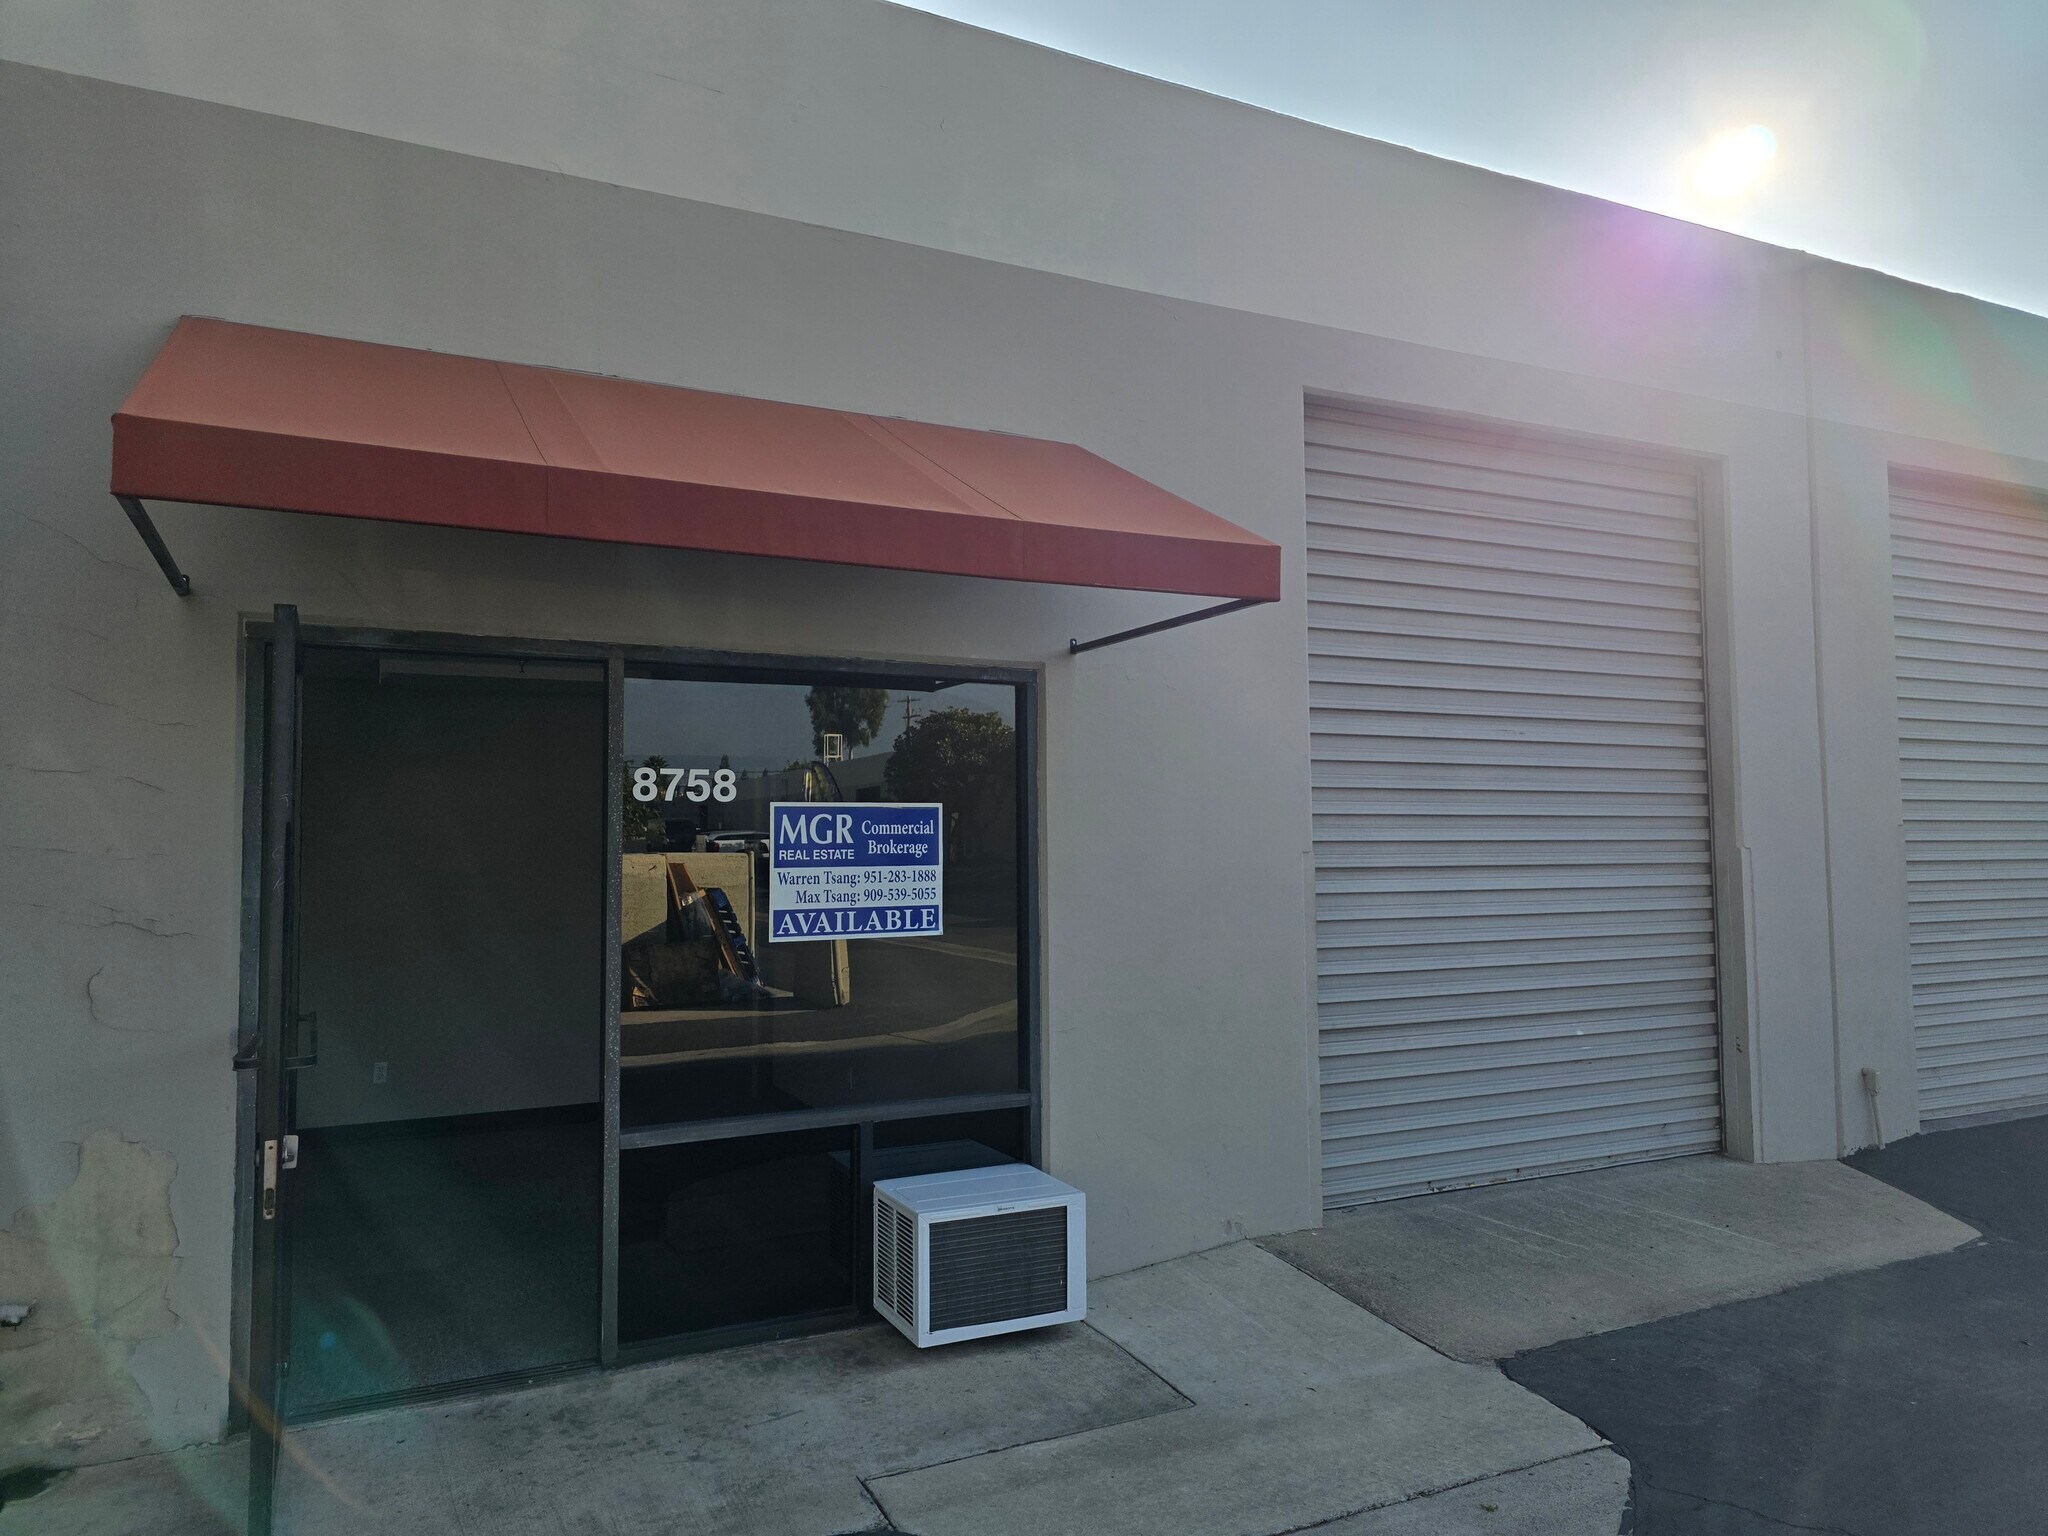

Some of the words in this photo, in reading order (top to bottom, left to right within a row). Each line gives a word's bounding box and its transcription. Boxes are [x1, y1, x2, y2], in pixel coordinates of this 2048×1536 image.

[632, 767, 737, 802] 8758
[779, 813, 854, 844] MGR
[861, 820, 934, 835] Commercial
[779, 850, 810, 860] REAL
[813, 849, 855, 860] ESTATE
[868, 840, 928, 857] Brokerage
[777, 872, 820, 885] Warren
[824, 871, 861, 888] Tsang:
[864, 870, 937, 883] 951-283-1888
[795, 890, 820, 904] Max
[824, 889, 861, 906] Tsang:
[864, 888, 937, 901] 909-539-5055
[776, 908, 936, 935] AVAILABLE
